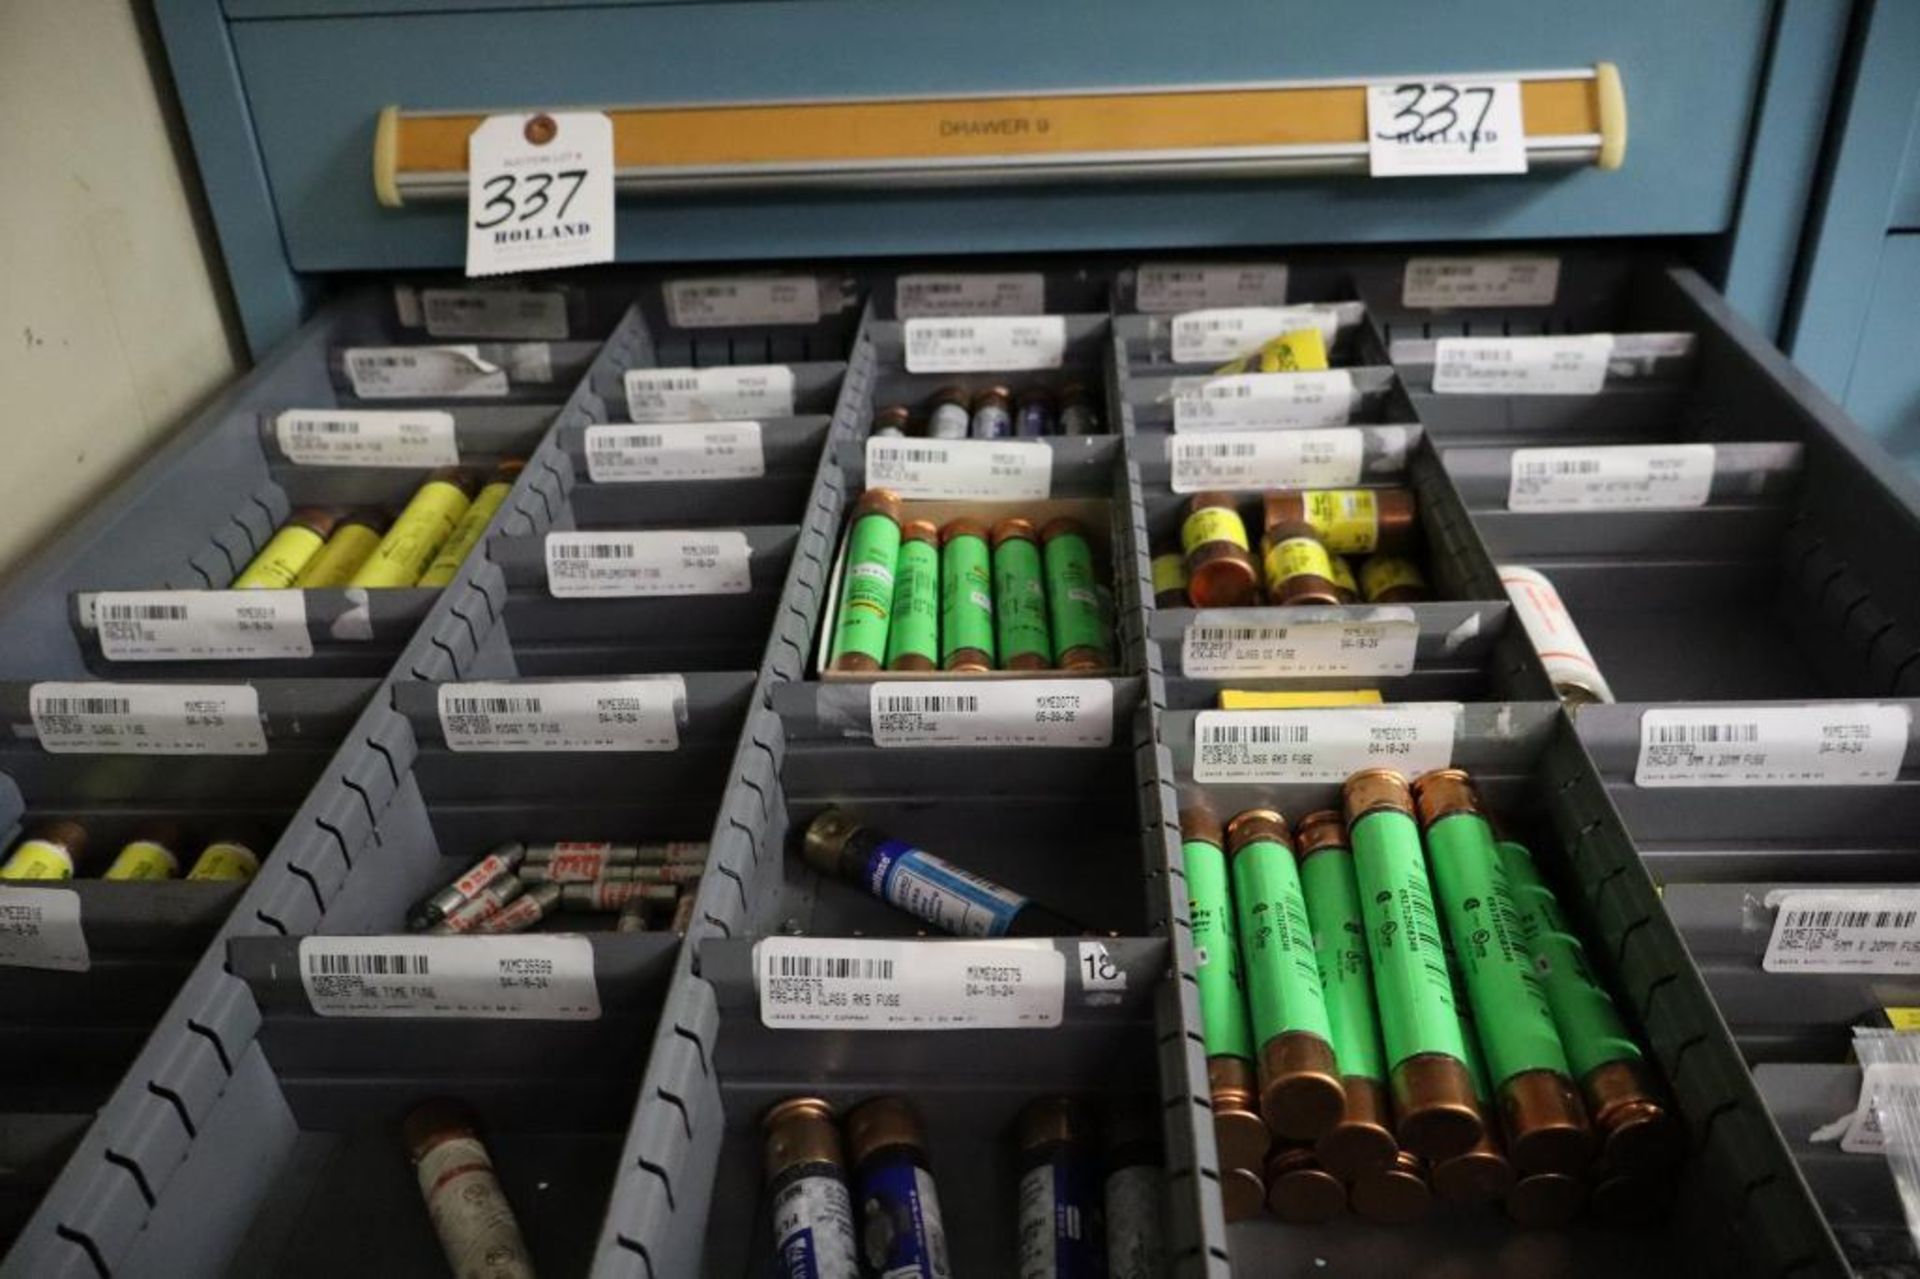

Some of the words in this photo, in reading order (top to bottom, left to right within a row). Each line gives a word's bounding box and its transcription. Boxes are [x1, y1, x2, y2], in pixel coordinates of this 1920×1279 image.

[940, 119, 1030, 137] DRAWER
[1036, 118, 1050, 135] 9
[1377, 84, 1496, 152] 337
[475, 169, 588, 229] 337
[493, 223, 591, 244] HOLLAND
[1242, 754, 1268, 765] CLASS
[1292, 753, 1313, 764] FUSE
[817, 991, 847, 1007] CLASS
[852, 993, 871, 1006] RK5
[876, 993, 901, 1007] FUSE
